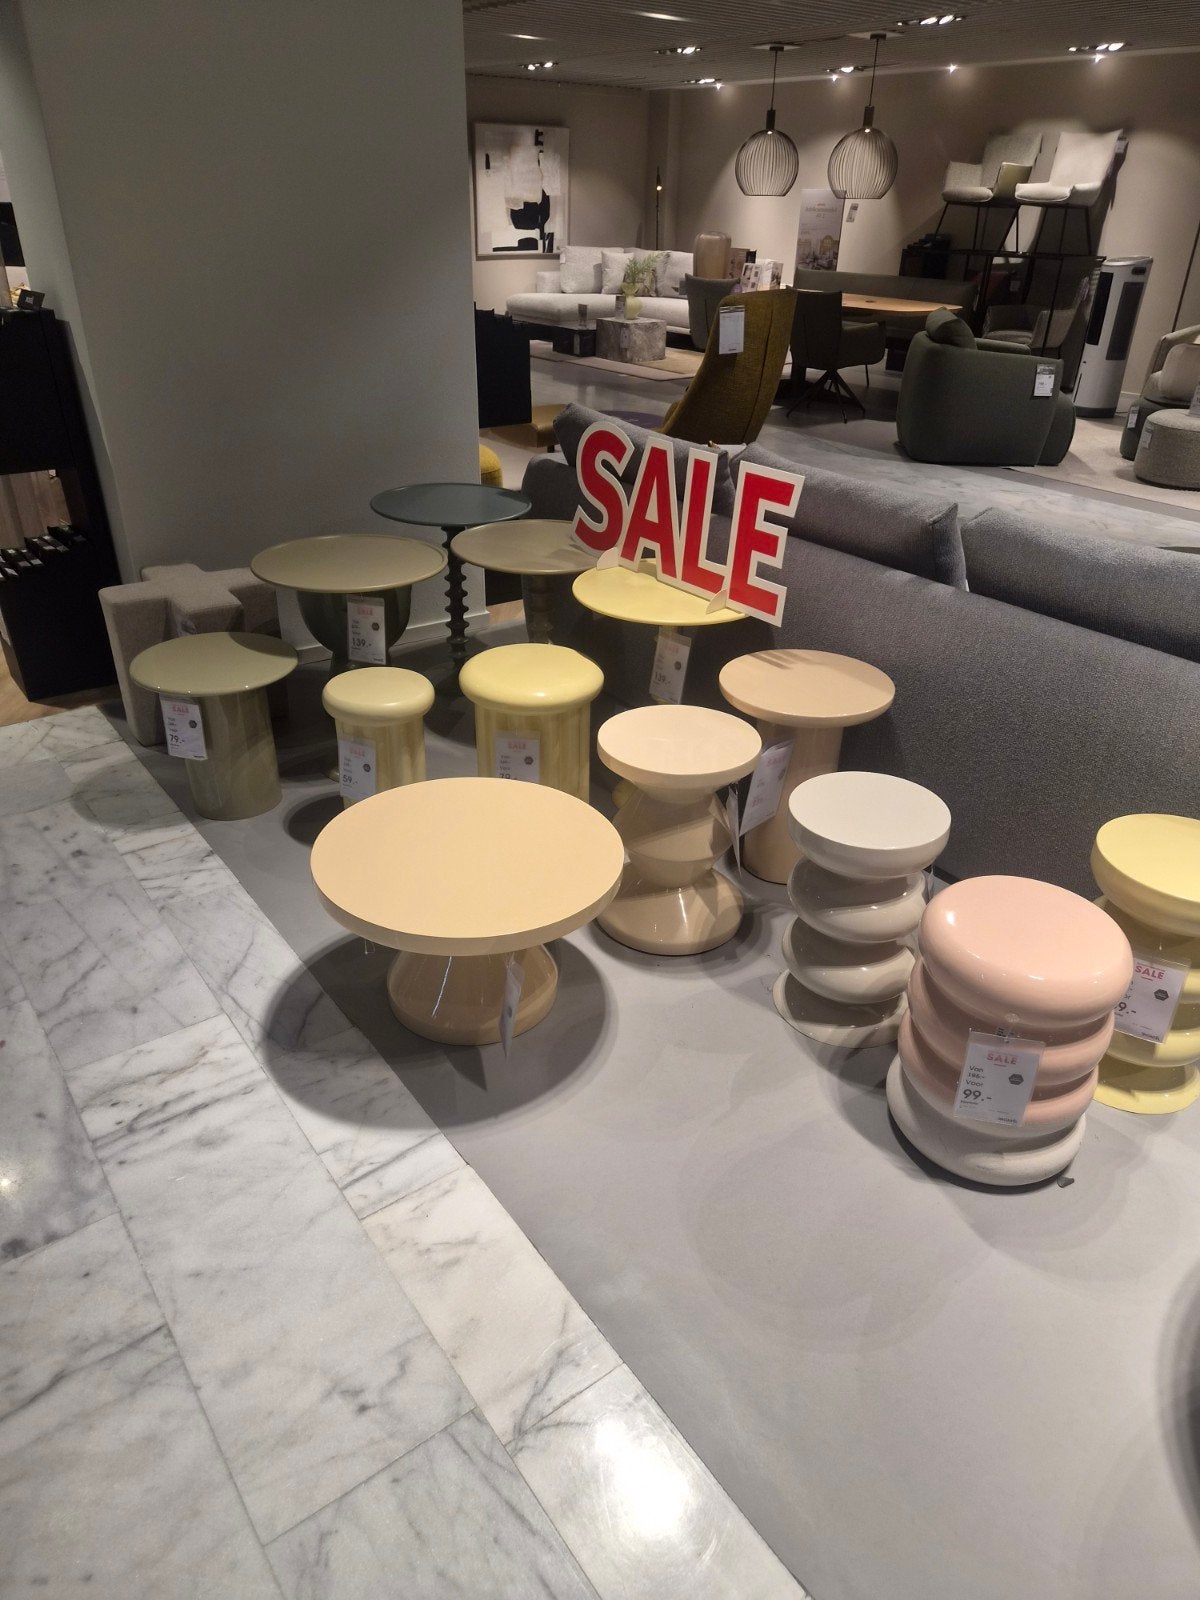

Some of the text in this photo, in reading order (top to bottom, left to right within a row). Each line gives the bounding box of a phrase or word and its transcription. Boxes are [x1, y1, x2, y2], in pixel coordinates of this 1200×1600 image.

[573, 428, 798, 618] SALE
[1135, 965, 1165, 980] SALE
[986, 1053, 1018, 1066] SALE
[969, 1065, 984, 1073] Van
[965, 1079, 983, 1087] Voor
[963, 1088, 993, 1102] 99.-
